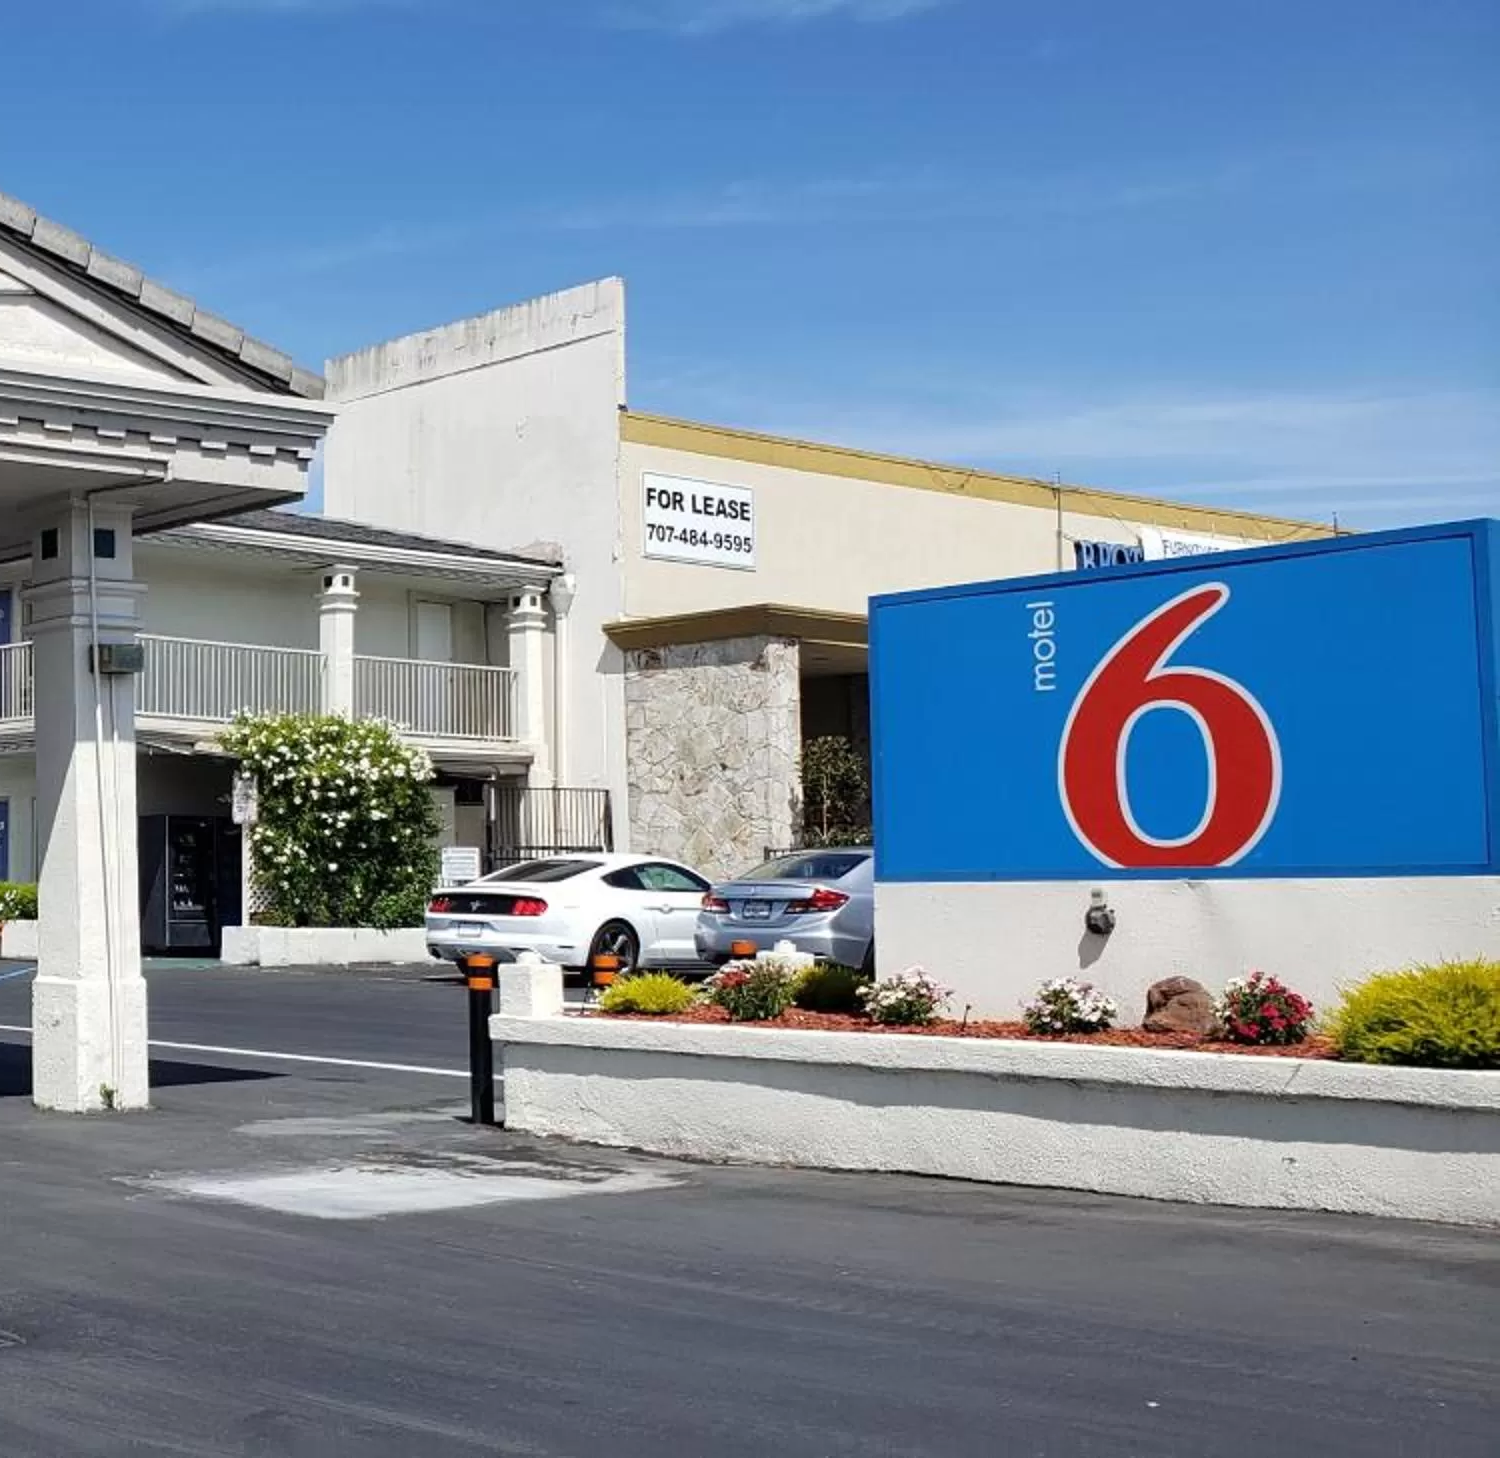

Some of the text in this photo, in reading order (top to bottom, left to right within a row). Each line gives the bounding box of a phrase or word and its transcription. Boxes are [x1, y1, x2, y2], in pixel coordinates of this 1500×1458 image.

[646, 487, 751, 522] FOR LEASE
[646, 523, 753, 553] 707-484-9595
[1025, 581, 1282, 868] motel 6
